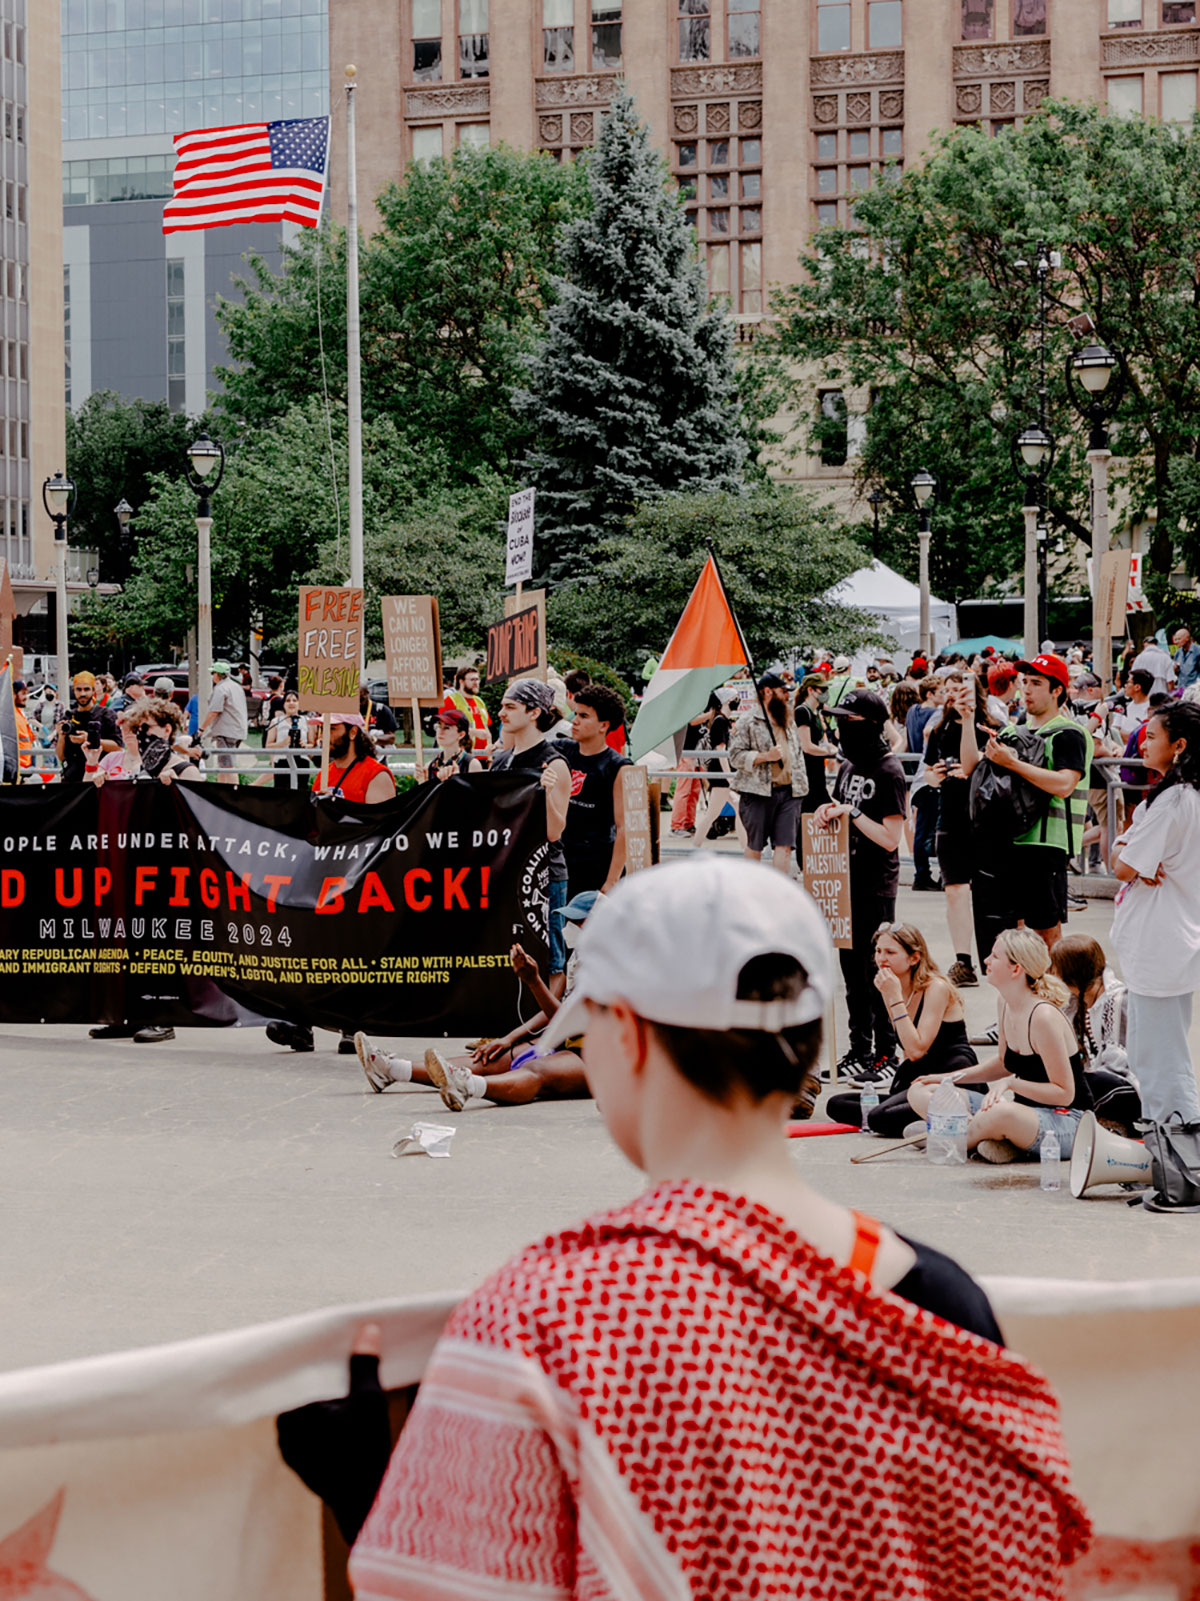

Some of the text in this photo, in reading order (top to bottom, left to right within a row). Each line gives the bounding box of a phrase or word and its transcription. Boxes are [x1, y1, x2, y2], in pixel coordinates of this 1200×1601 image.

[522, 492, 532, 503] THE
[509, 534, 530, 551] CUBA
[305, 590, 362, 622] FREE
[393, 598, 416, 615] WE
[388, 616, 426, 633] CAN NO
[304, 628, 358, 660] FREE
[390, 636, 428, 653] LONGER
[392, 656, 430, 673] AFFORD
[298, 662, 360, 698] PALESTINE
[390, 676, 434, 692] THE RICH
[70, 833, 109, 851] ARE
[117, 832, 189, 850] UNDER
[197, 834, 298, 862] ATTACK,
[314, 842, 375, 861] WHAT
[379, 834, 409, 852] DO
[426, 831, 459, 849] WE
[472, 828, 512, 848] DO?
[811, 836, 838, 853] WITH
[806, 853, 847, 875] PALESTINE
[55, 866, 112, 908] UP
[135, 866, 292, 913] FIGHT
[314, 865, 491, 915] BACK!
[812, 879, 842, 897] STOP
[39, 917, 292, 947] MILWAUKEE 2024
[527, 912, 542, 932] ON
[22, 949, 96, 961] REPUBLICAN
[97, 948, 130, 960] AGENDA
[143, 950, 188, 963] PEACE,
[192, 950, 237, 966] EQUITY,
[238, 954, 259, 967] AND
[261, 956, 309, 970] JUSTICE
[311, 957, 338, 970] FOR
[341, 957, 368, 970] ALL
[380, 957, 419, 969] STAND
[422, 956, 453, 969] WITH
[22, 962, 91, 974] IMMIGRANT
[93, 962, 121, 974] RIGHTS
[130, 962, 176, 975] DEFEND
[180, 963, 240, 980] WOMEN'S,
[279, 970, 303, 984] AND
[306, 970, 404, 985] REPRODUCTIVE
[406, 971, 450, 984] RIGHTS
